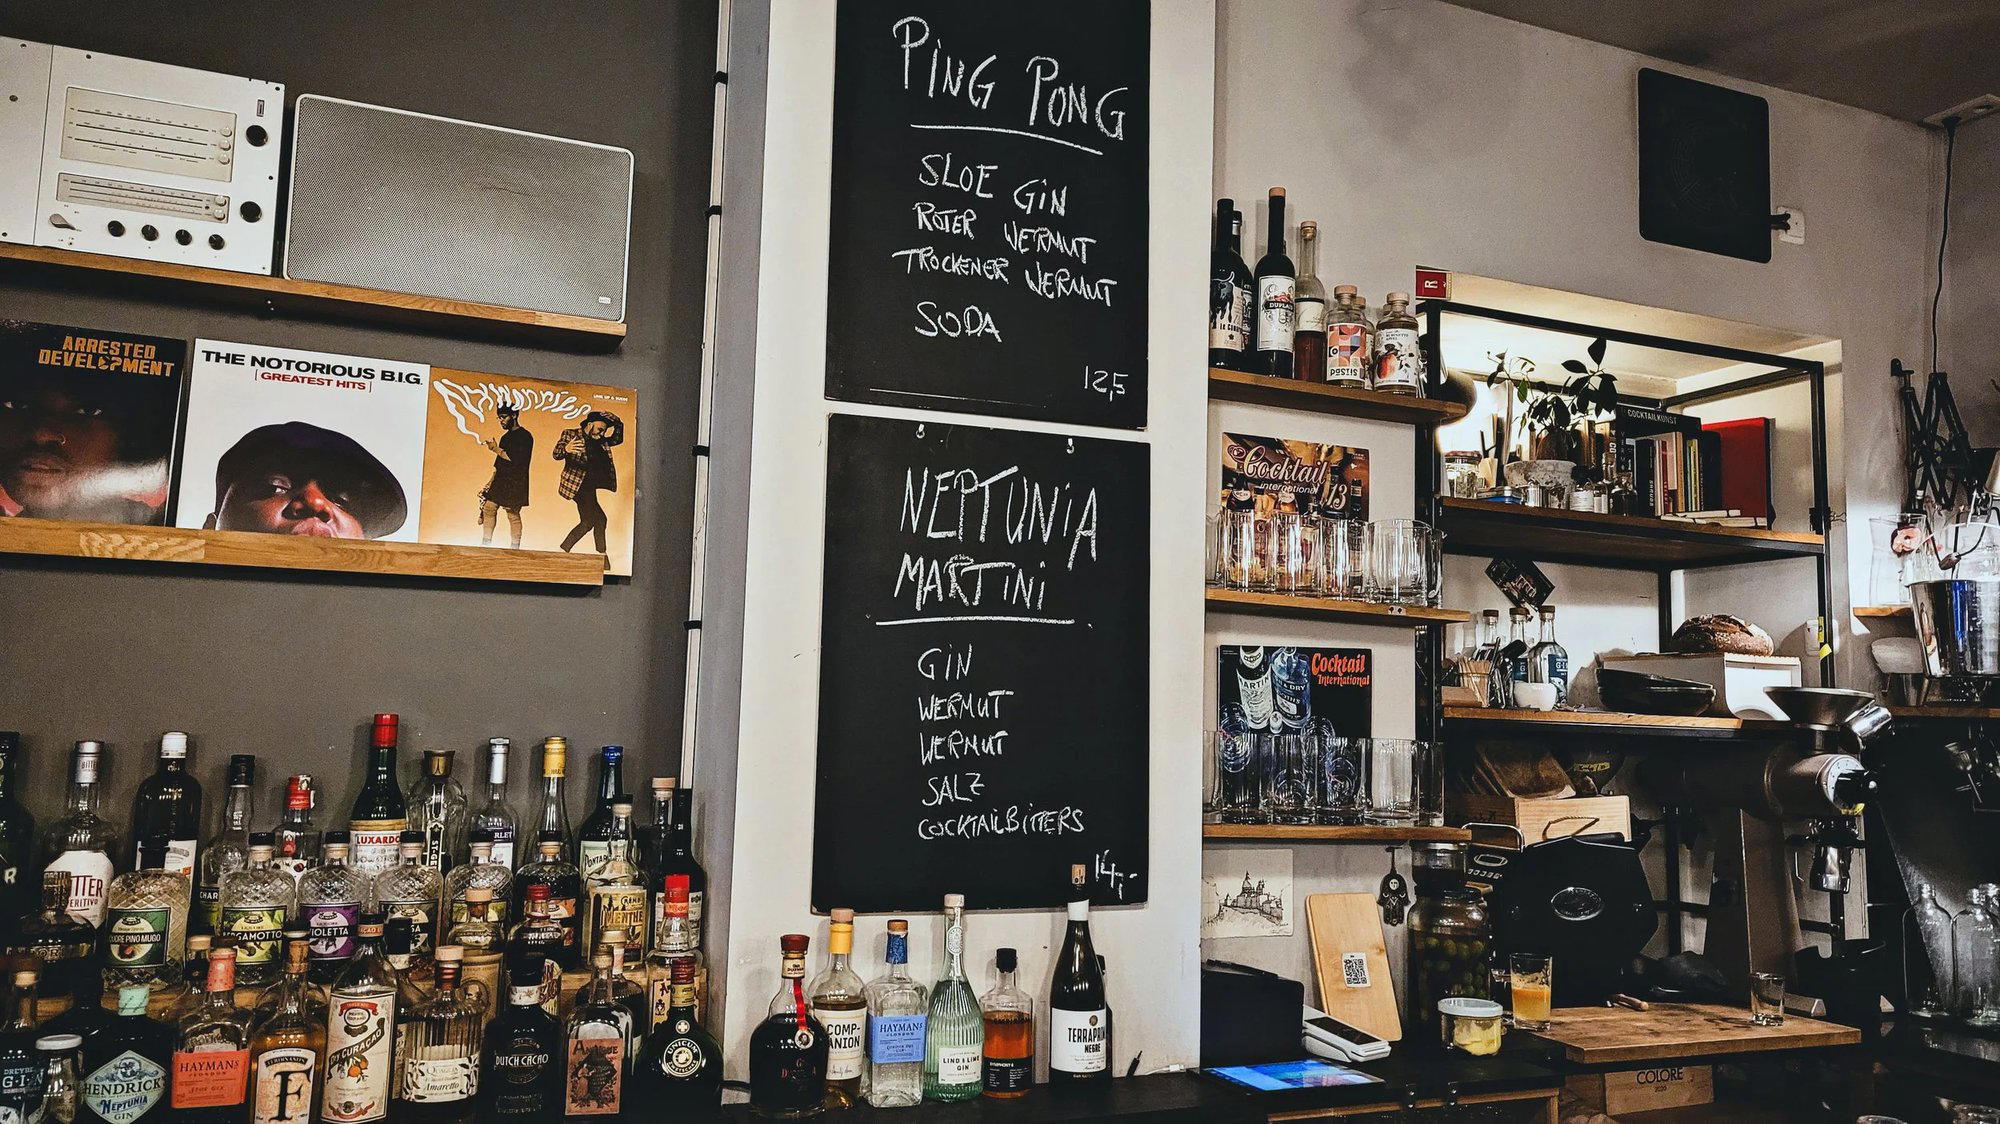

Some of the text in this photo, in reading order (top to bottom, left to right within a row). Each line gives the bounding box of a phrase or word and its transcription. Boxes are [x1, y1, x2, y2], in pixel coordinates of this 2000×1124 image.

[1026, 55, 1128, 140] PONG
[919, 153, 998, 198] SLOE
[913, 202, 1096, 264] ROTER WERMUT
[892, 246, 1117, 306] TROCKENER WERMUT
[914, 301, 1002, 342] SODA
[62, 335, 156, 360] ARRESTED
[202, 350, 423, 386] THE NOTORIOUS B.I.G.
[1627, 409, 1677, 425] COCKTAILKUNST
[1228, 444, 1328, 485] Cocktail
[1260, 481, 1319, 495] international
[1322, 483, 1348, 510] 13
[1312, 652, 1366, 676] Cocktail
[1317, 673, 1370, 687] International
[919, 690, 1014, 722] WERMUT
[922, 773, 985, 807] SALZ
[355, 835, 400, 844] LUXARDO
[125, 934, 140, 943] PINO
[141, 933, 161, 942] MUGO
[667, 1040, 699, 1055] UNICUM
[1084, 1043, 1101, 1054] NEGRE
[496, 1053, 549, 1067] DUTCH CACAO
[967, 1055, 980, 1063] LIME
[1637, 1067, 1684, 1085] COLORE
[100, 1095, 148, 1115] NEPTUNIA
[114, 1111, 134, 1121] GIN
